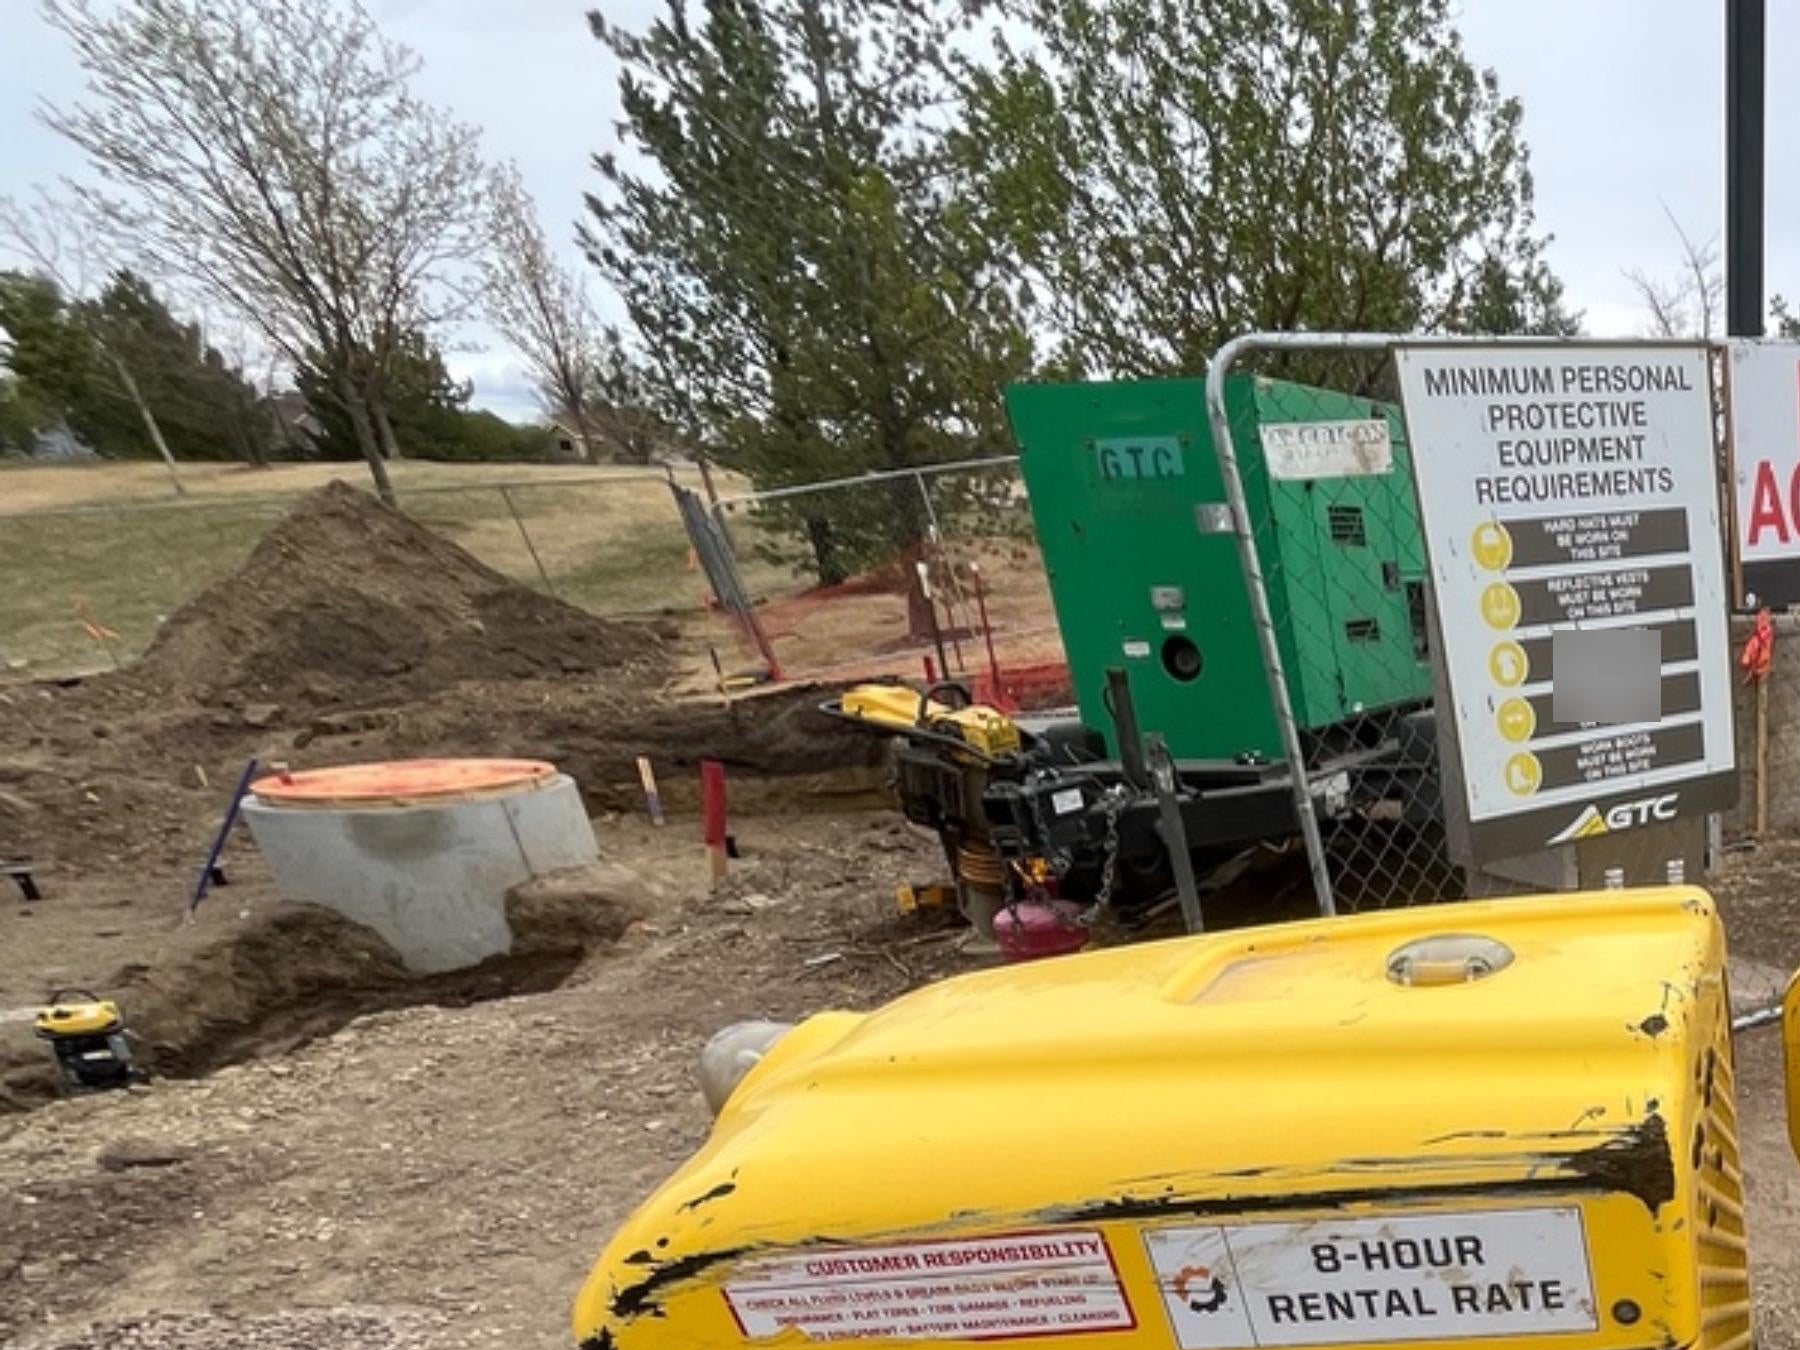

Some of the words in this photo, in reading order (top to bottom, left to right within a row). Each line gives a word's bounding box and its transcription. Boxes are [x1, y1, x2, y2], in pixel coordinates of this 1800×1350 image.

[1424, 367, 1554, 396] MINIMUM
[1561, 365, 1692, 394] PERSONAL
[1488, 401, 1648, 431] PROTECTIVE
[1101, 446, 1172, 480] GTC
[1497, 435, 1645, 467] EQUIPMENT
[1476, 467, 1674, 504] REQUIREMENTS
[1606, 792, 1680, 829] GTC
[806, 1253, 920, 1276] CUSTOMER
[922, 1241, 1100, 1267] RESPONSIBILITY
[1311, 1235, 1485, 1274] 8-HOUR
[1268, 1287, 1437, 1326] RENTAL
[1451, 1280, 1564, 1315] RATE
